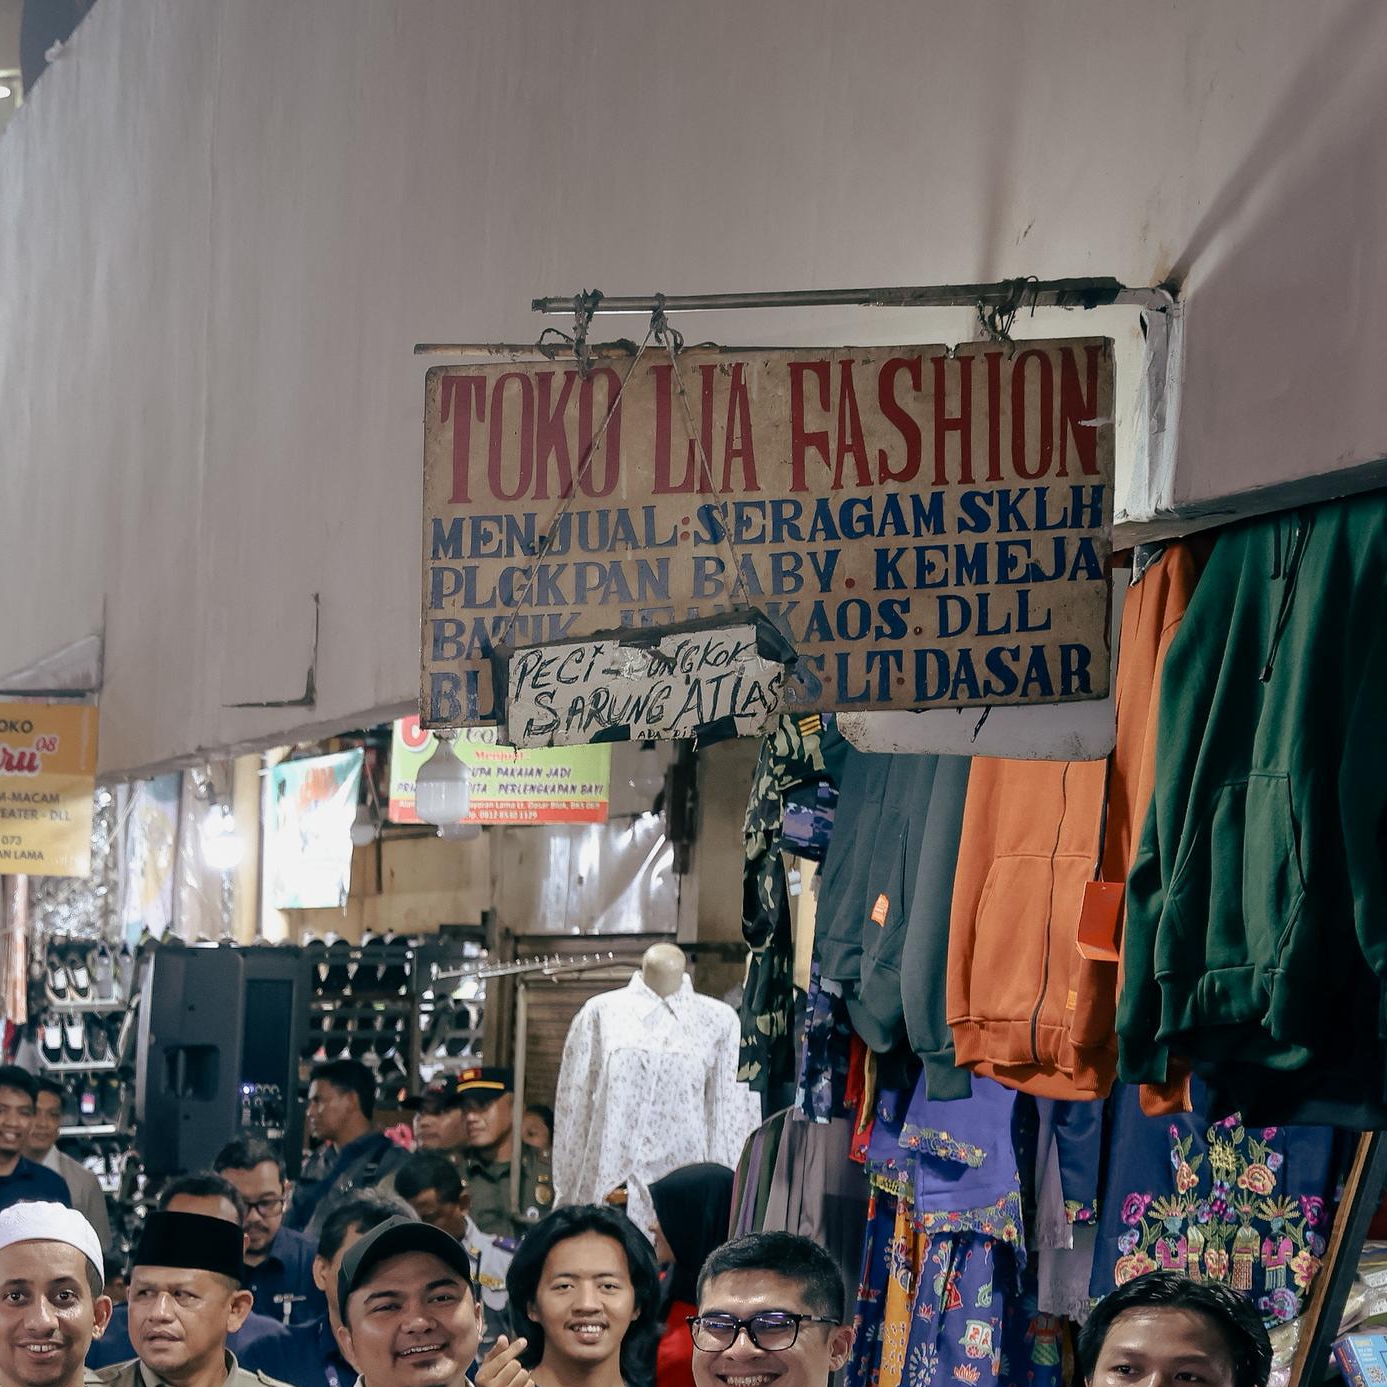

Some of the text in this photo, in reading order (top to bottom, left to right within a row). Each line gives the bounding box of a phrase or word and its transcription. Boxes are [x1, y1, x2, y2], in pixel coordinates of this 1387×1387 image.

[440, 344, 1103, 504] TOKO LIA FASHION
[693, 490, 945, 545] SERAGAM
[957, 484, 1107, 535] SKLH
[429, 558, 672, 610] PLGKPAN
[873, 536, 1106, 591] KEMEJA
[936, 589, 1052, 638] DLL
[914, 643, 1093, 703] DASAR
[524, 681, 672, 739] SARUNG
[664, 668, 783, 733] ATLAS
[496, 768, 543, 777] PAKAIAN
[546, 768, 572, 777] JADI
[498, 783, 577, 793] PERLENGKAPAN
[50, 810, 72, 821] DLL
[14, 849, 44, 860] LAMA
